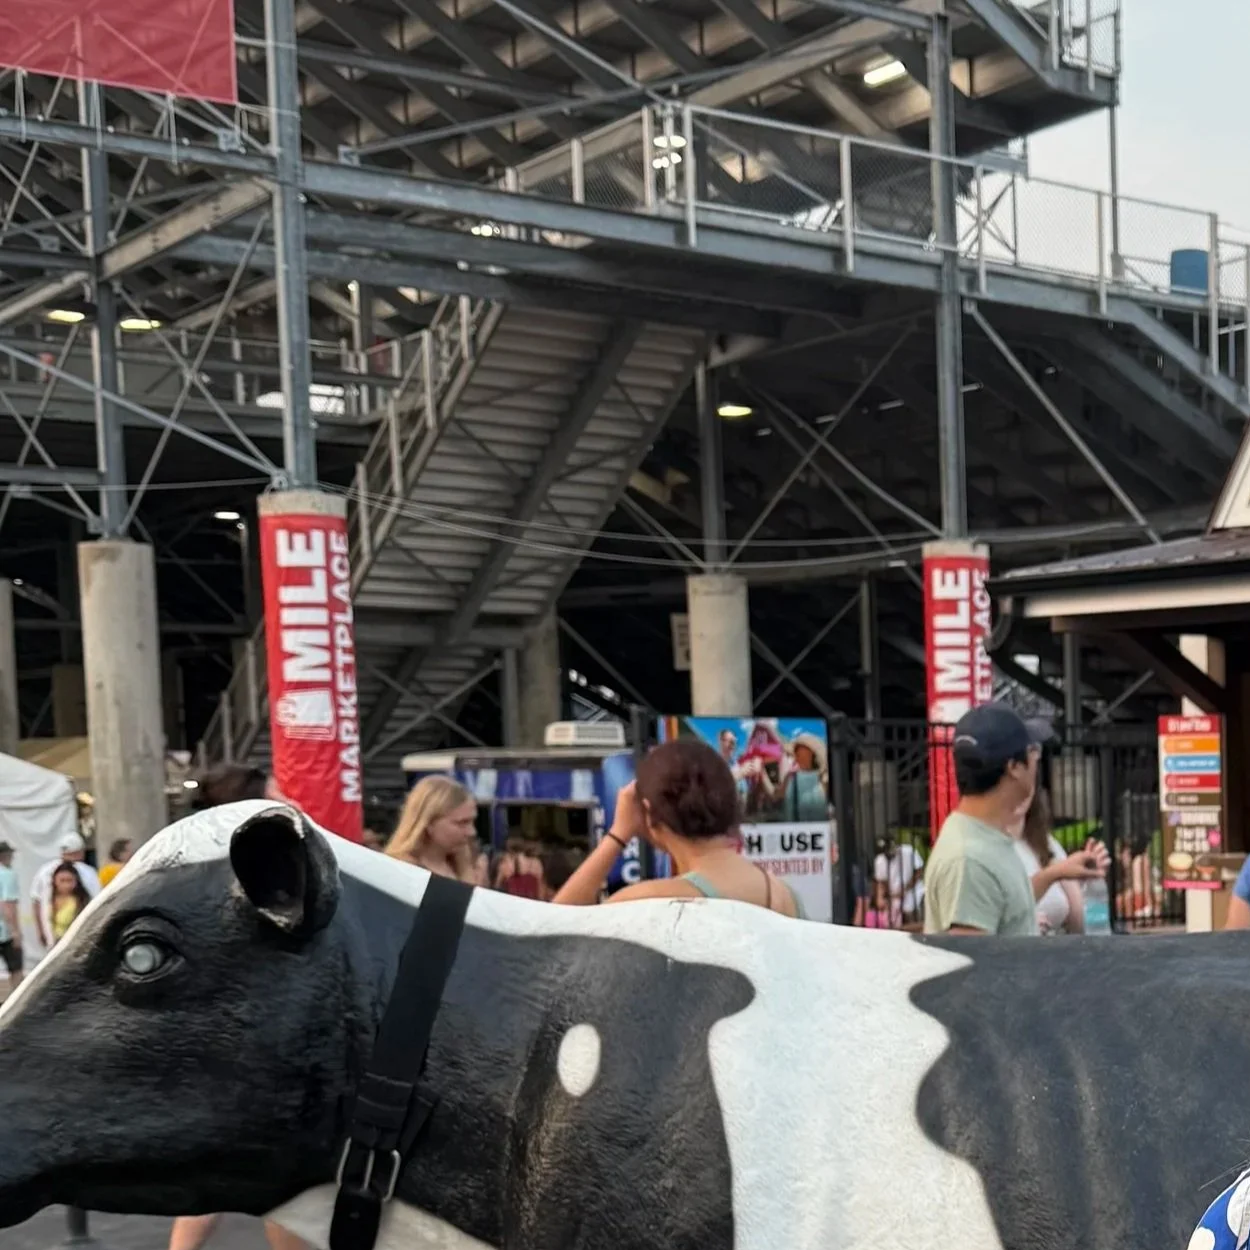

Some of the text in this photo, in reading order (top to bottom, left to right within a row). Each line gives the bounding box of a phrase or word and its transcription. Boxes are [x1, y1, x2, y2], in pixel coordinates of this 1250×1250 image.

[274, 529, 333, 682] MILE
[329, 530, 362, 802] MARKETPLACE
[931, 568, 971, 692] MILE
